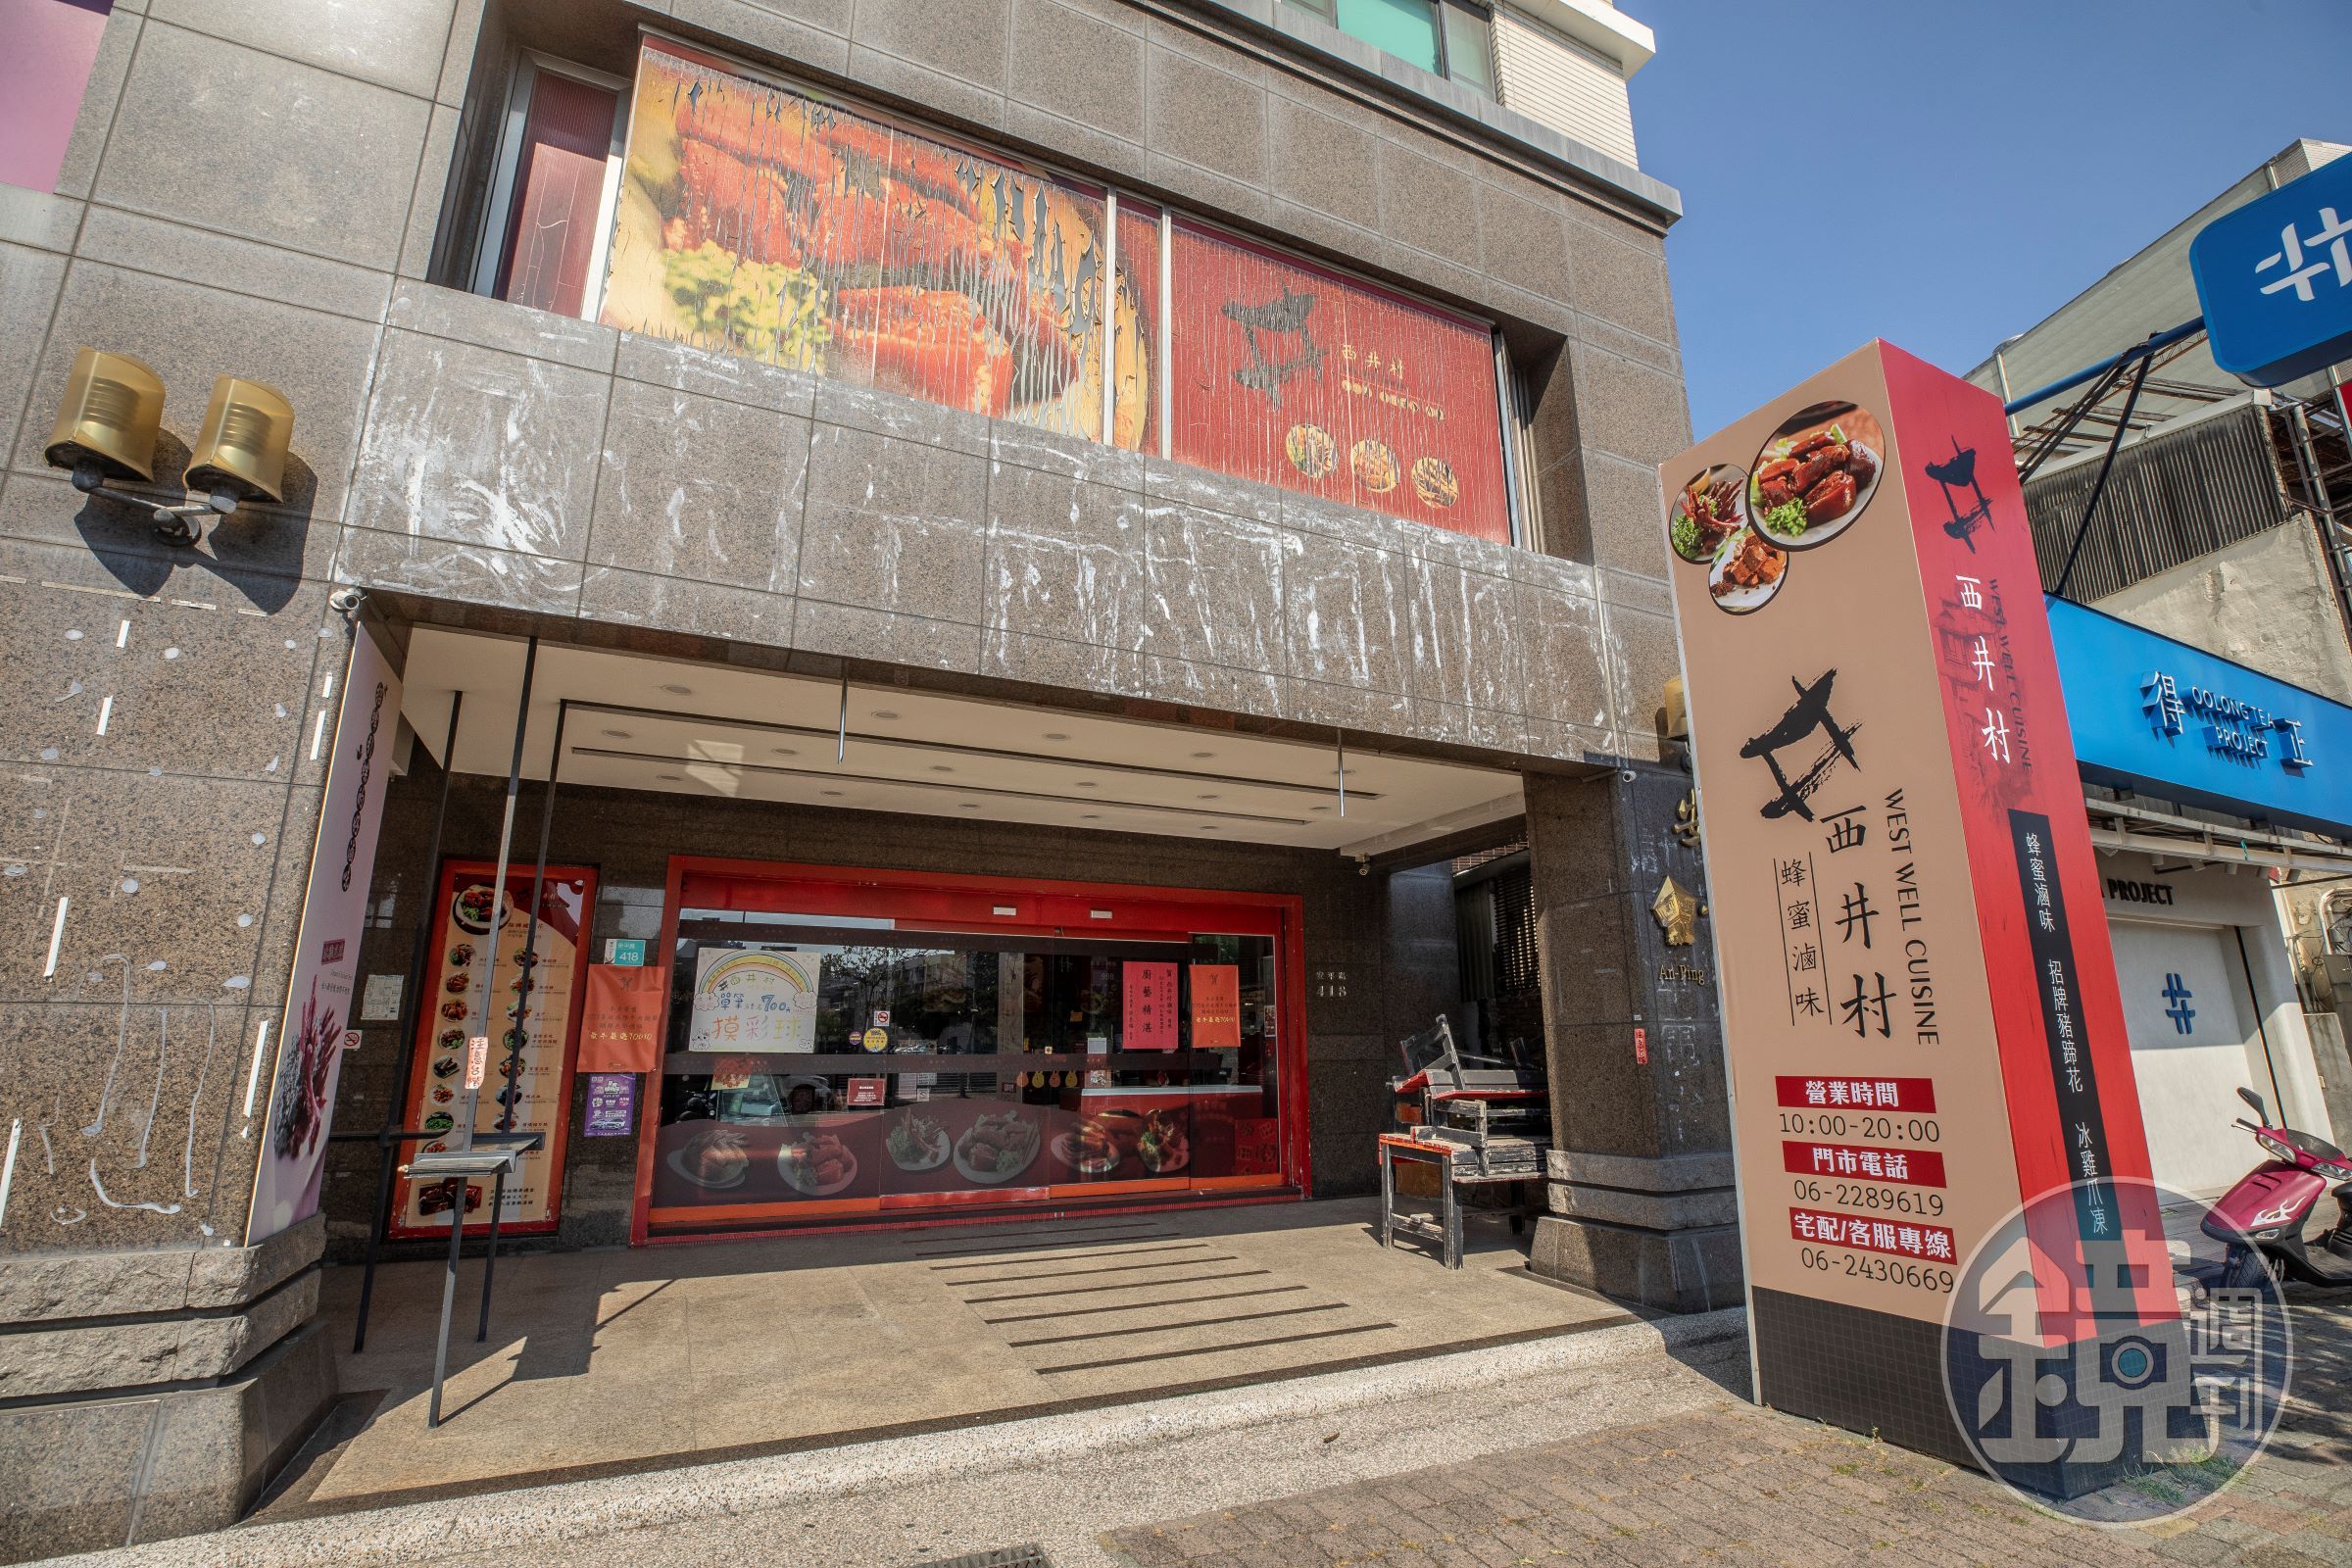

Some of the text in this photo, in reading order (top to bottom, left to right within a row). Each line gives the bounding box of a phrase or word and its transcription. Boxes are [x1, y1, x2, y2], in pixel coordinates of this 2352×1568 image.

[1955, 573, 2010, 763] 西井村
[1988, 578, 2032, 777] WEST WELL CUISINE
[2150, 670, 2314, 767] 得 正
[2191, 685, 2276, 729] OOLONG TEA
[2215, 726, 2269, 759] PROJECT
[2107, 878, 2173, 906] PROJECT
[1781, 858, 1825, 1017] 蜂蜜滷味
[1819, 805, 1897, 1040] 西井村
[1883, 787, 1939, 1047] WEST WELL CUISINE
[618, 952, 639, 961] 418
[1658, 964, 1705, 986] An-Ping
[2026, 832, 2056, 933] 蜂蜜滷味
[2047, 958, 2084, 1094] 招牌豬蹄花
[1316, 985, 1347, 998] 418
[1805, 1080, 1899, 1107] 營業時間
[1779, 1112, 1940, 1143] 10:00-20:00
[1812, 1147, 1909, 1180] 門市電話
[1793, 1179, 1943, 1216] 06-2289619
[1794, 1211, 1953, 1259] 宅配/客服專線
[1801, 1247, 1954, 1294] 06-2430669
